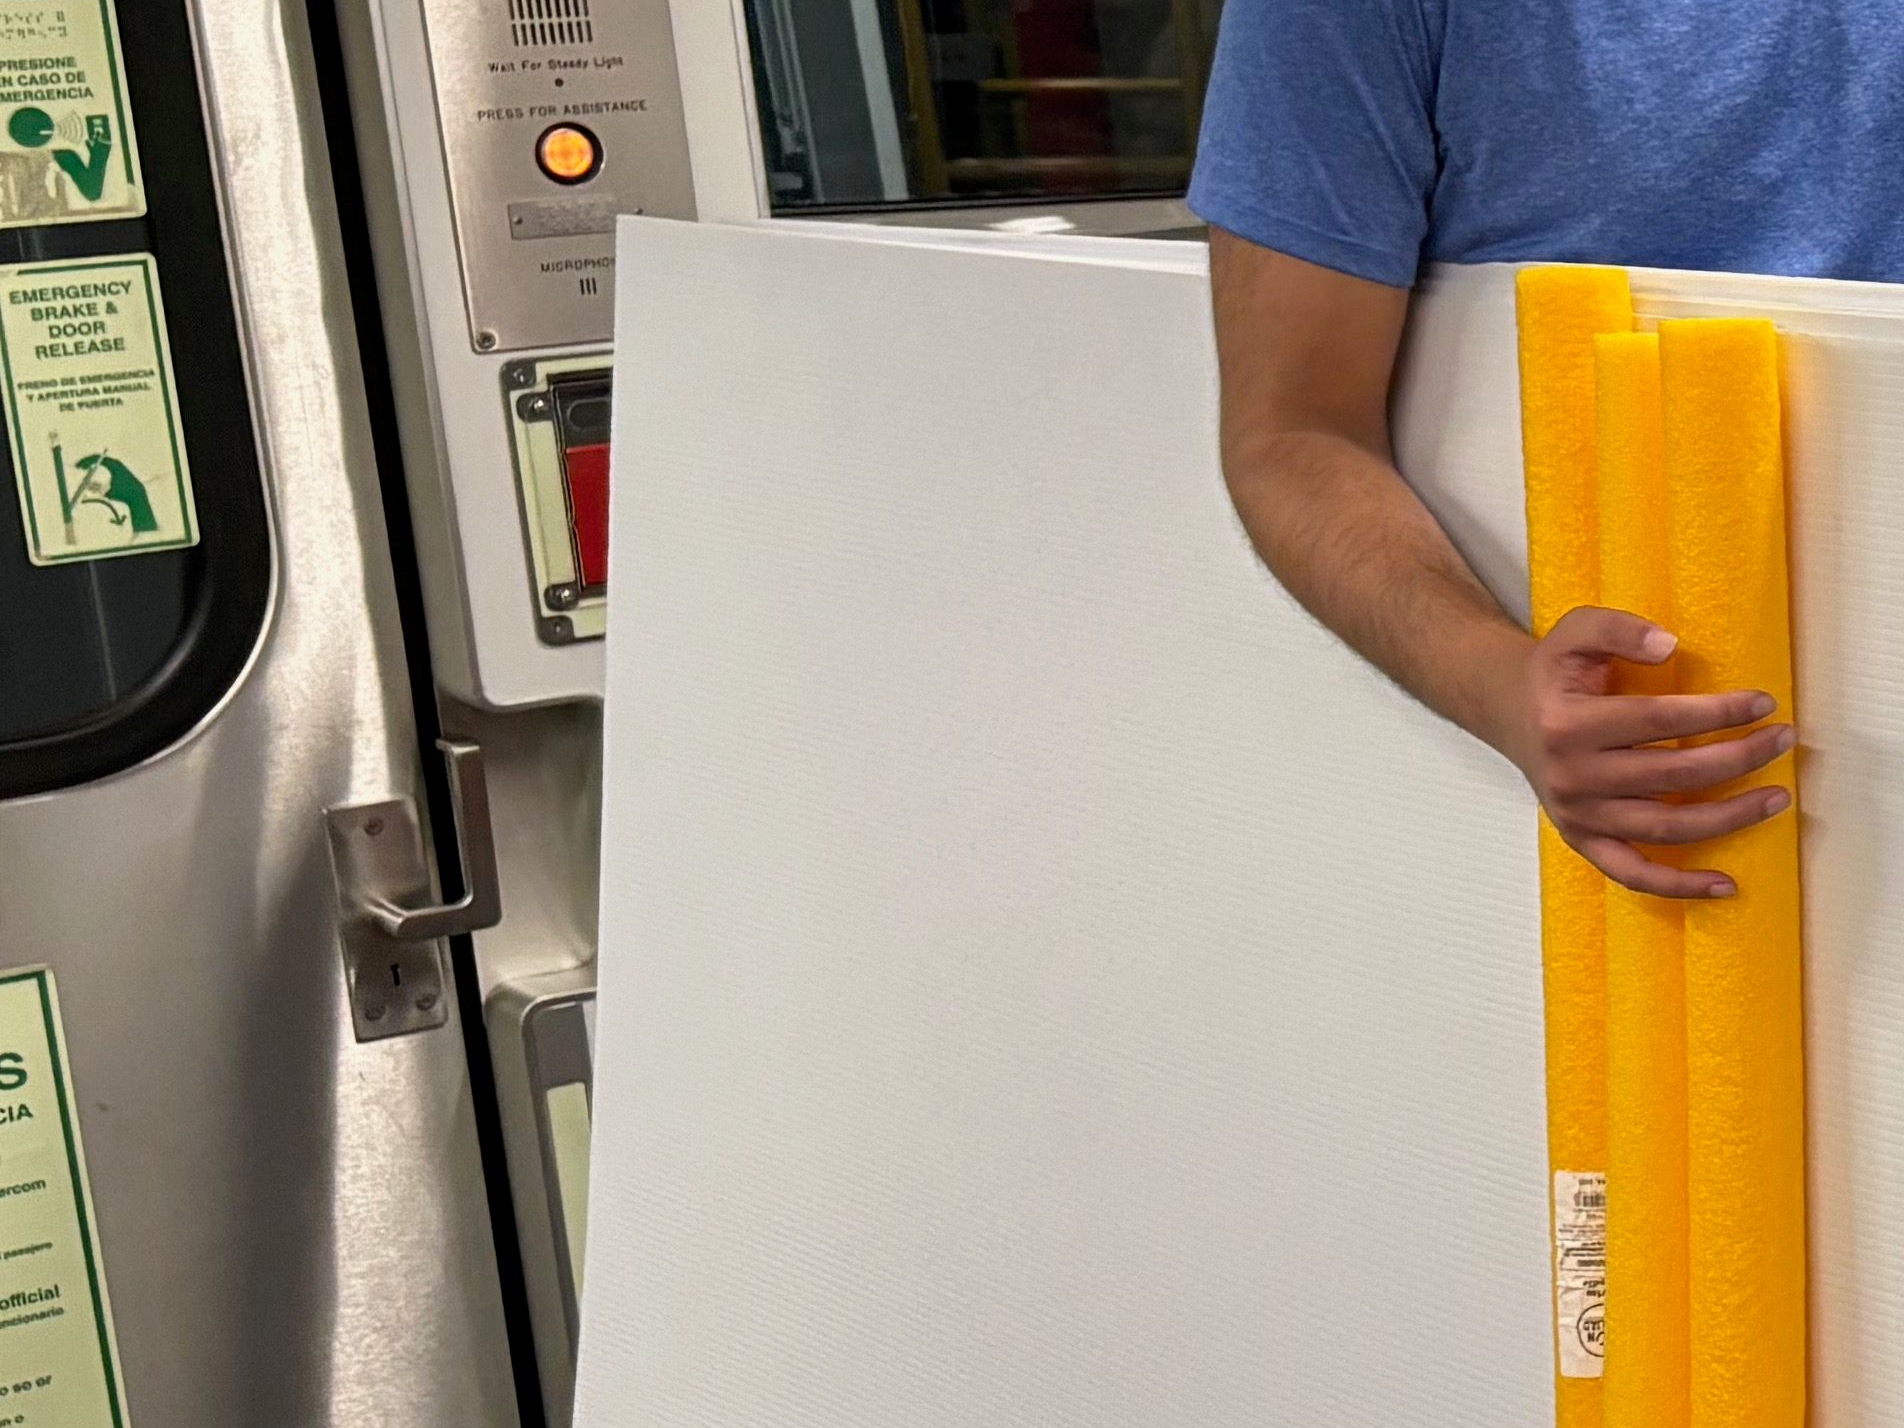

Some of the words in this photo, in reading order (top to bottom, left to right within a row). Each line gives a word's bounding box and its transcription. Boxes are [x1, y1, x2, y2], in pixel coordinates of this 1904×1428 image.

[522, 60, 541, 70] For
[18, 72, 61, 86] CASO
[65, 71, 86, 84] DE
[477, 109, 524, 122] PRESS
[529, 105, 558, 117] FOR
[564, 100, 648, 115] ASSISTANCE
[9, 281, 131, 305] EMERGENCY
[31, 303, 99, 321] BRAKE
[105, 301, 118, 314] &
[48, 321, 106, 339] DOOR
[35, 337, 126, 360] RELEASE
